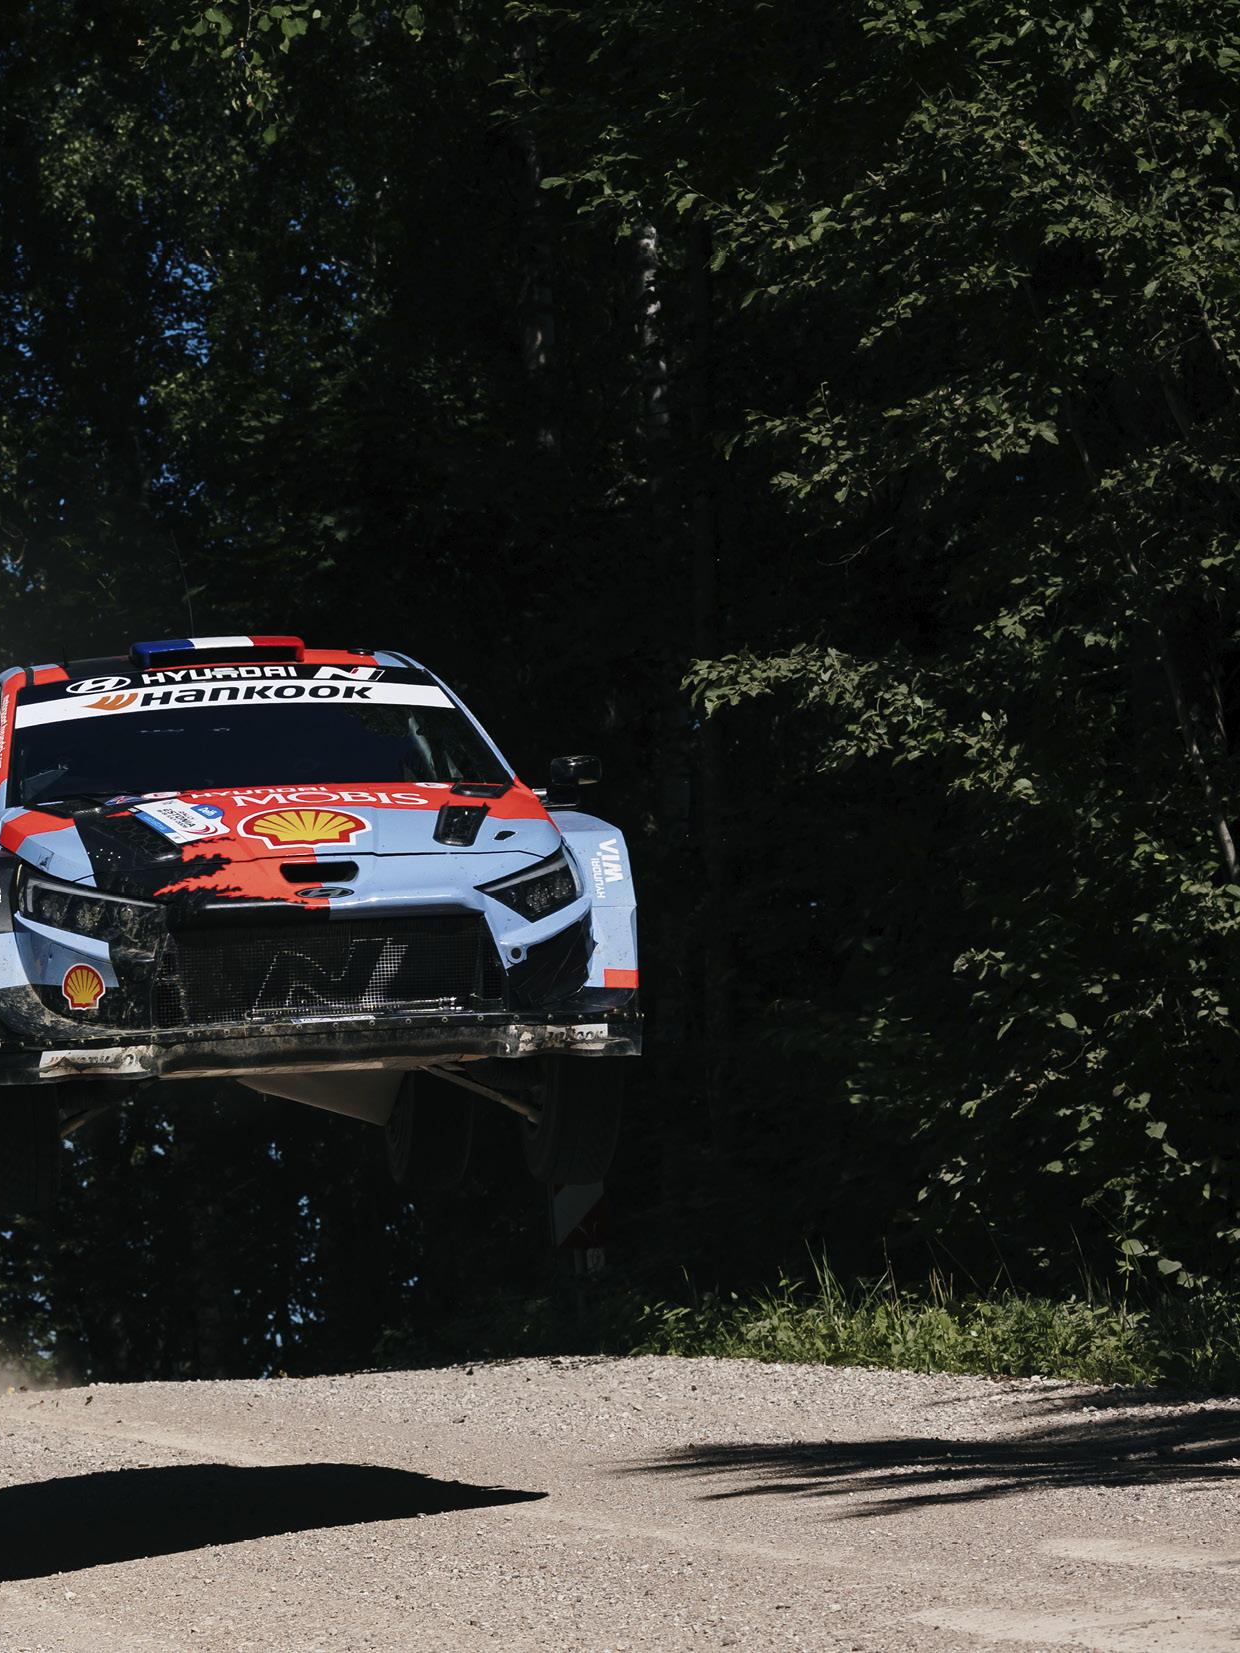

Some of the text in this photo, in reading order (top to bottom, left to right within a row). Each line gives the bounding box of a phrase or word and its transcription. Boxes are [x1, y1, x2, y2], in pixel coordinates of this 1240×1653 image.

[141, 666, 297, 685] HYUNDAI
[191, 786, 328, 799] HYUNDAI
[231, 791, 429, 807] MOBIS
[591, 858, 606, 899] HYUNDAI
